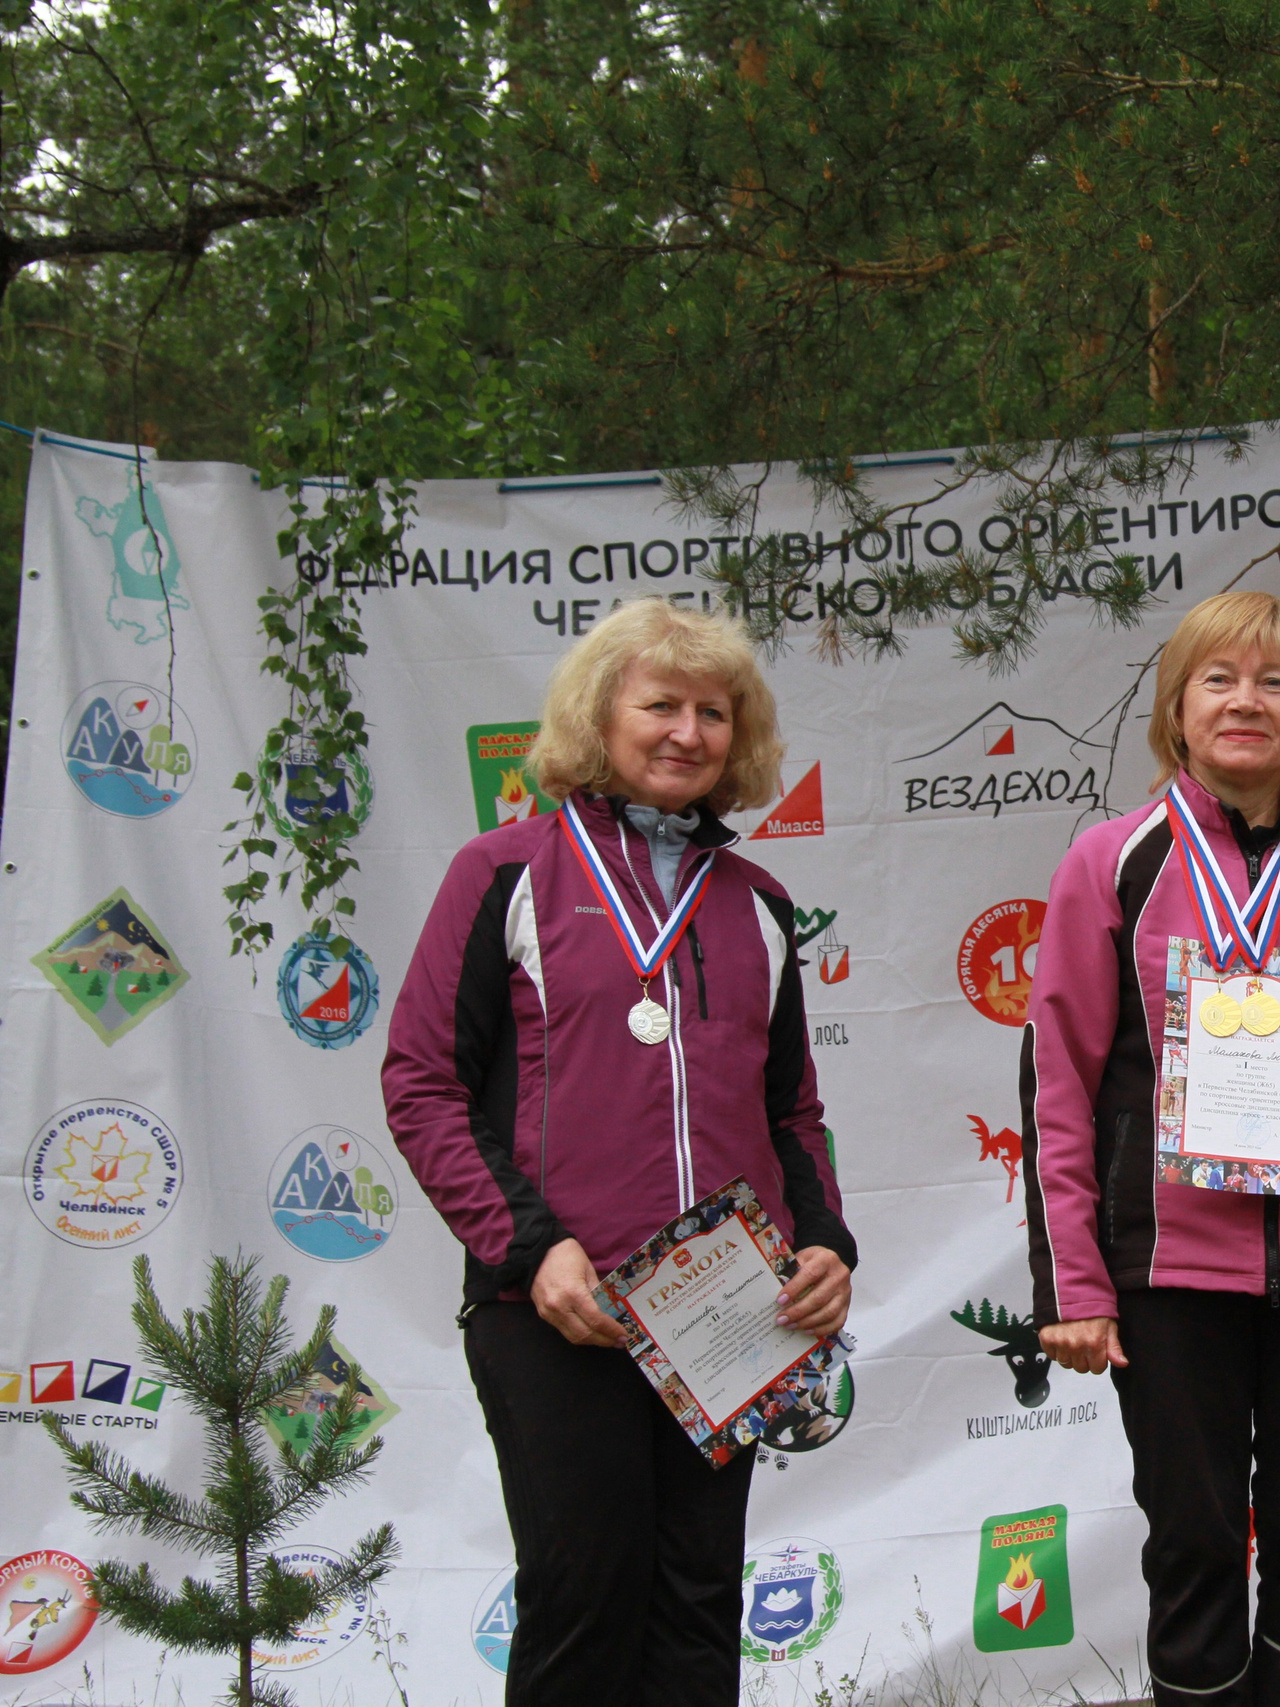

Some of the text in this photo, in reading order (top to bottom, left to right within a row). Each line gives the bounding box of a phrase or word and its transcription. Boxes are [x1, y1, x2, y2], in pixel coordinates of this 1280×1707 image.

[478, 745, 532, 759] ПОЛЯН
[904, 766, 1100, 818] ВЕЗДЕХОД
[766, 819, 822, 834] Миасс
[960, 902, 1029, 1002] ГОРЯЧАЯ ДЕСЯТКА
[320, 1007, 347, 1019] 2016
[813, 1023, 849, 1046] ЛОСЬ
[58, 1106, 149, 1130] первенство
[150, 1126, 178, 1172] СШОР
[32, 1129, 59, 1202] Открытое
[59, 1200, 146, 1215] Челябинск
[156, 1198, 169, 1209] 5
[56, 1215, 142, 1241] Осенний лист
[646, 1239, 738, 1311] ГРАМОТА
[92, 1415, 158, 1430] СТАРТЫ
[966, 1401, 1098, 1440] КЫШТЫМСКИЙ ЛОСЬ
[993, 1515, 1057, 1536] МАЙСКАЯ
[991, 1528, 1055, 1549] ПОЛЯНА
[0, 1551, 47, 1587] ОРНЫЙ
[755, 1566, 819, 1583] ЧЕБАРКУЛЬ
[770, 1563, 807, 1572] эстафеты
[291, 1648, 320, 1665] лист
